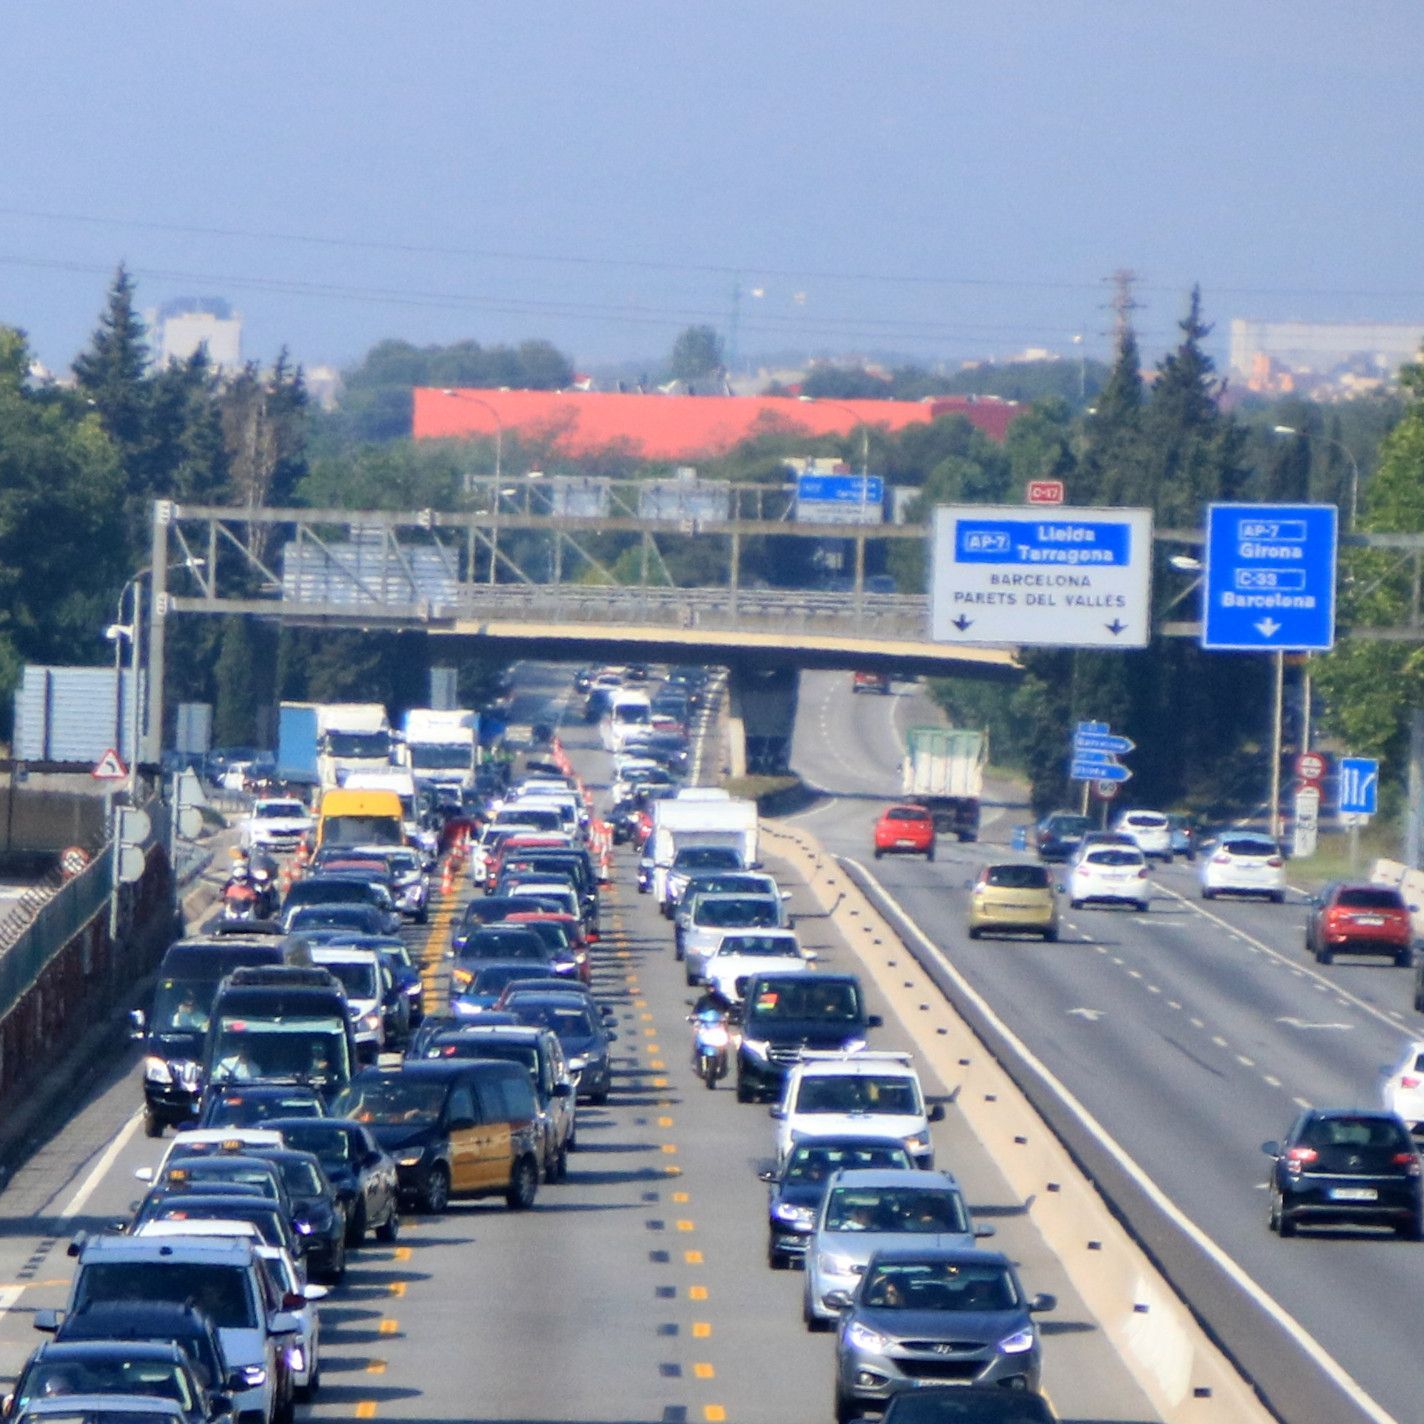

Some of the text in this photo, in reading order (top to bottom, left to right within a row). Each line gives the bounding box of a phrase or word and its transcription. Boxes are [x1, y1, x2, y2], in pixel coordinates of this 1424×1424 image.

[1037, 526, 1096, 542] Lleida
[1242, 525, 1280, 537] AP-7
[968, 536, 1006, 548] AP-7
[1016, 545, 1114, 564] Tarragona
[1240, 543, 1304, 559] Girona
[990, 573, 1092, 587] BARCELONA
[1239, 572, 1278, 586] C-33
[953, 591, 1018, 605] PARETS
[1026, 593, 1057, 607] DEL
[1221, 591, 1316, 608] Barcelona
